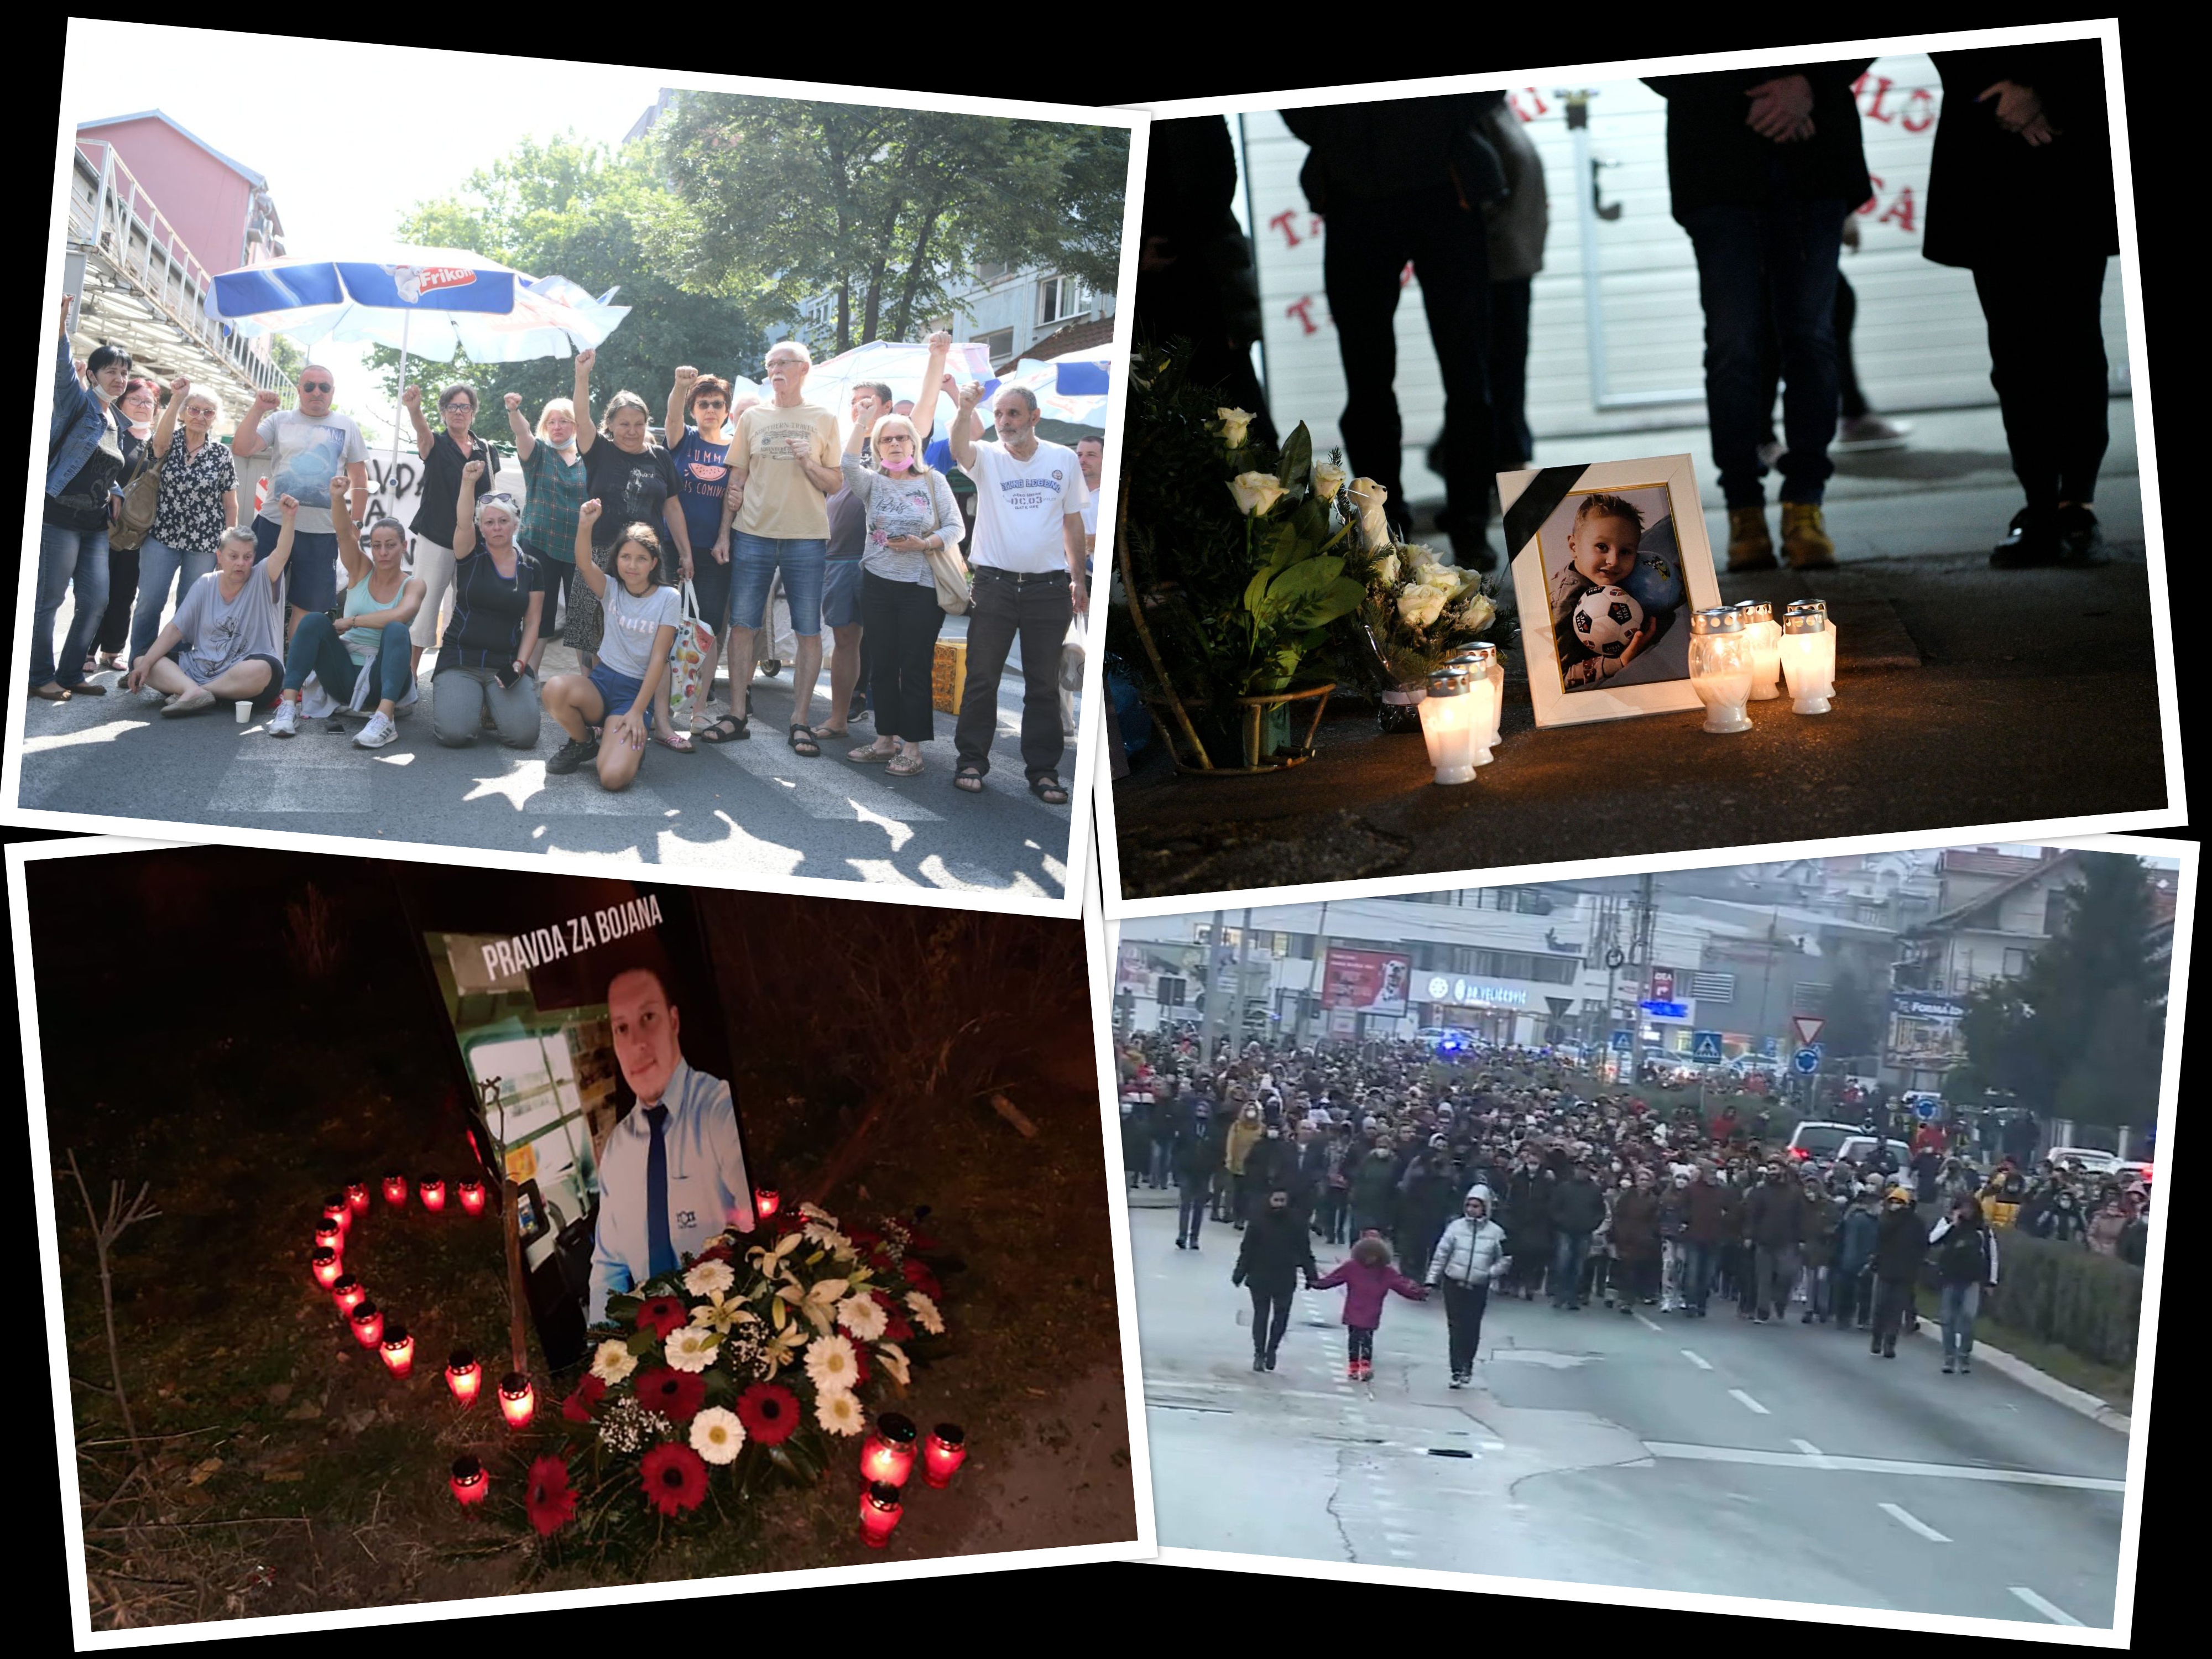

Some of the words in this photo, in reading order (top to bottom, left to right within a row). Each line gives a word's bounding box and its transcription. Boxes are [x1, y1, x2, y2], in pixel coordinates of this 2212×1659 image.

[684, 479, 692, 493] IS
[482, 924, 568, 982] PRAVDA
[567, 916, 596, 954] ZA
[594, 894, 664, 943] BOJANA
